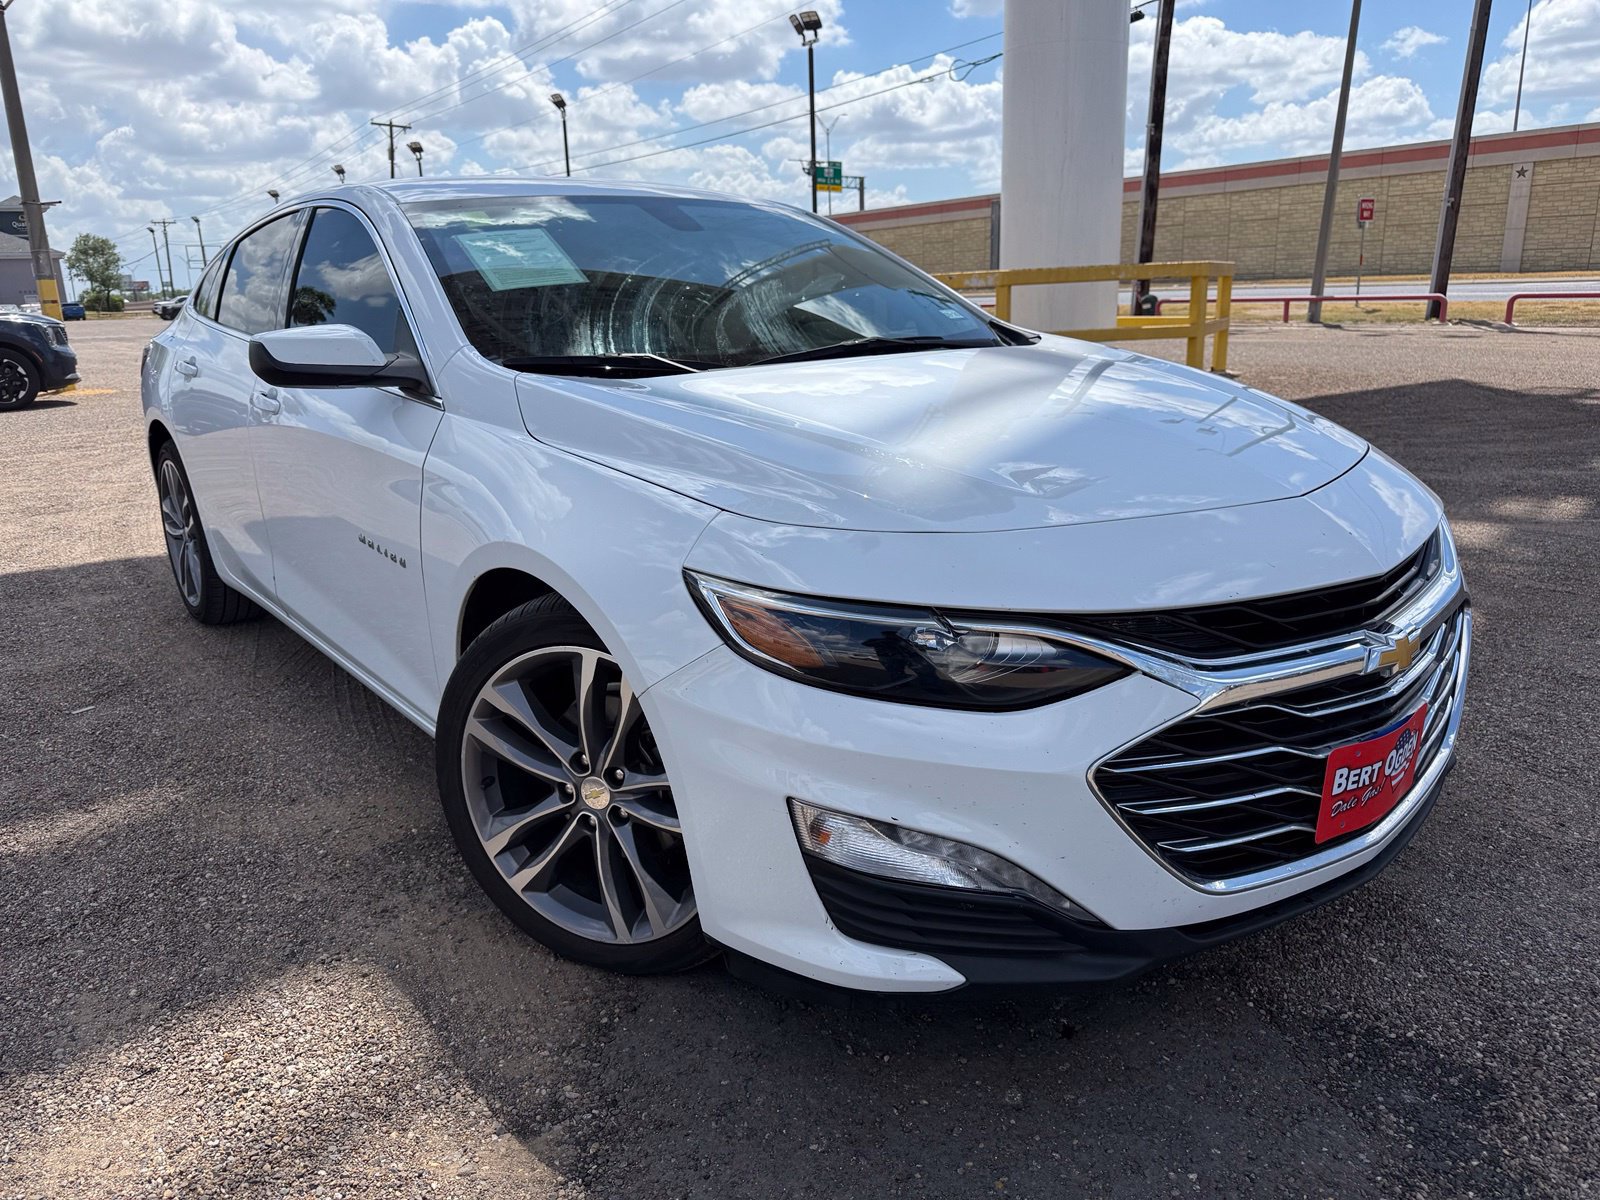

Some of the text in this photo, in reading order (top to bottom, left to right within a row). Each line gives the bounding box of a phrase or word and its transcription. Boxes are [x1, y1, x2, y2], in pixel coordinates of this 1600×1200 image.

[358, 533, 407, 569] MALIBU
[1331, 760, 1383, 796] BERT
[1331, 796, 1358, 817] Dale
